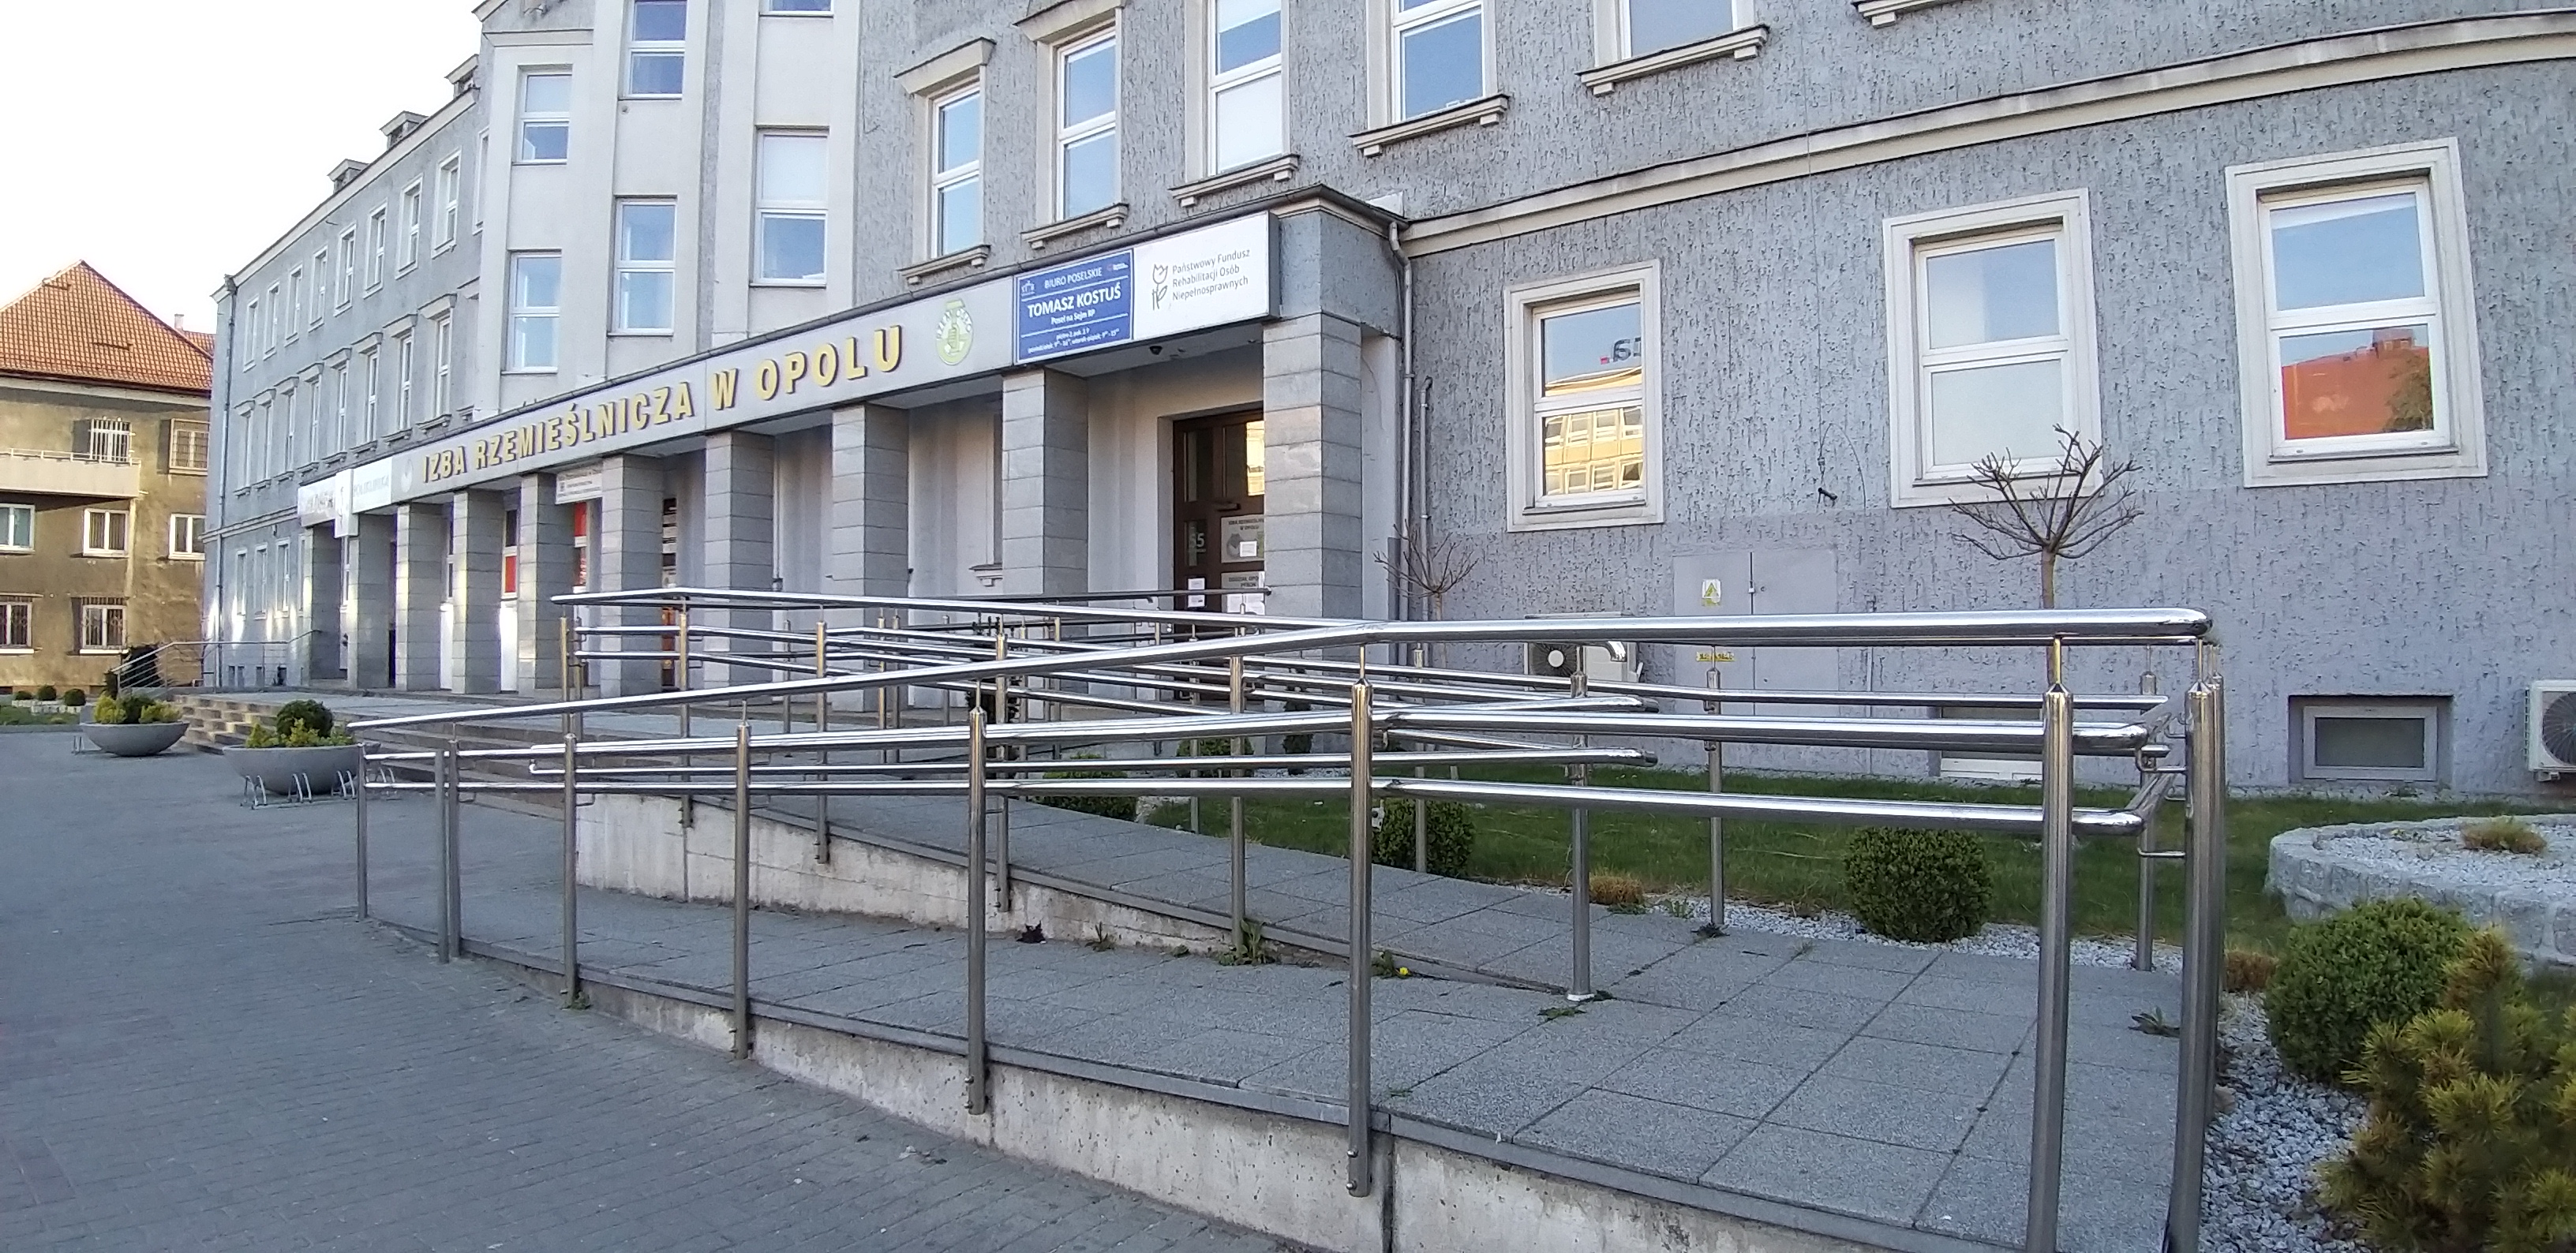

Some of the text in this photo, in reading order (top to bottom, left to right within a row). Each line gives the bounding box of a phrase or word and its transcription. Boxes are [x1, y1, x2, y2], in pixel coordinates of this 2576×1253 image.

[1172, 249, 1250, 275] Państwowy Fundusz
[1044, 276, 1066, 289] BIURO
[1067, 267, 1103, 284] POSELSKIE
[1172, 275, 1249, 301] Niepełnosprawnych
[1173, 264, 1240, 288] Rehabilitacji Osób
[1028, 281, 1121, 318] TOMASZ KOSTUŚ
[423, 324, 902, 484] IZBA RZEMIEŚLNICZA W OPOLU
